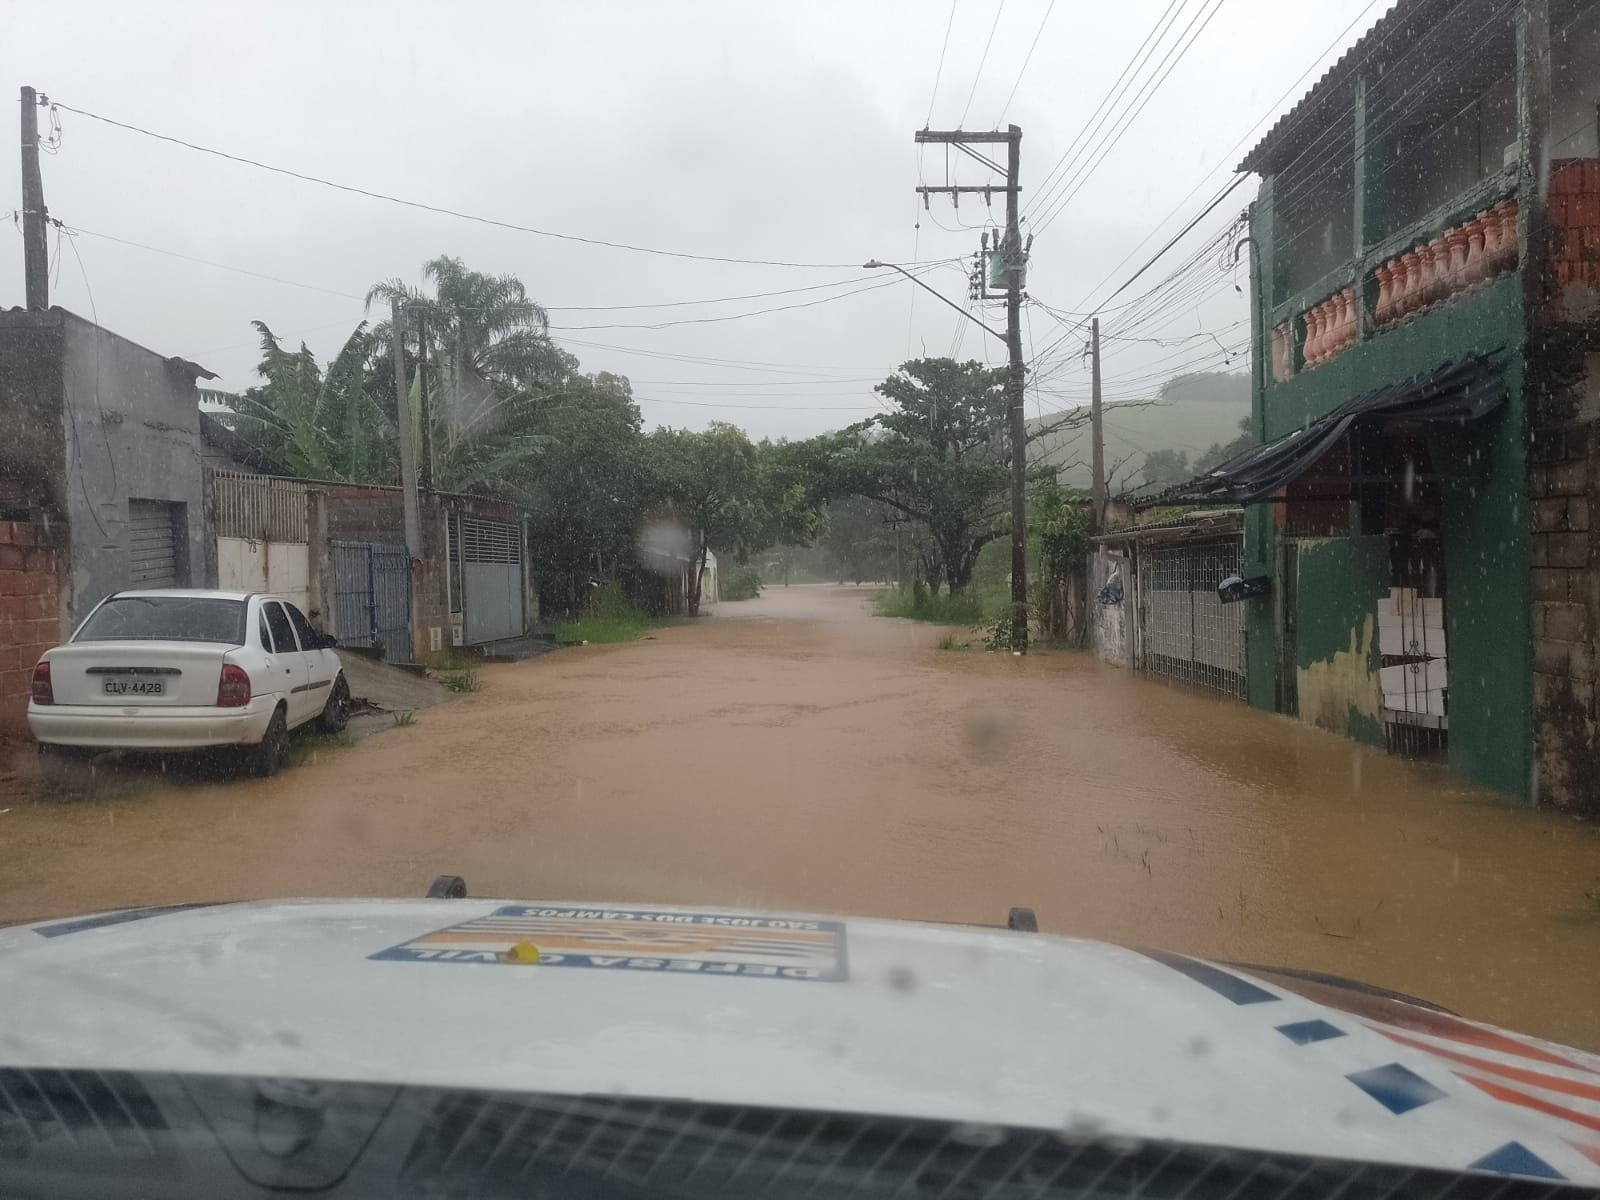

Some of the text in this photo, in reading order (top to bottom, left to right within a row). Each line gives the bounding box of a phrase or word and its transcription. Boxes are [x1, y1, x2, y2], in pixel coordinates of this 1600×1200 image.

[105, 682, 162, 694] CLV-4428
[523, 908, 635, 920] CAMPOS
[641, 914, 693, 923] DOS
[411, 950, 819, 977] DEFESA CVIL
